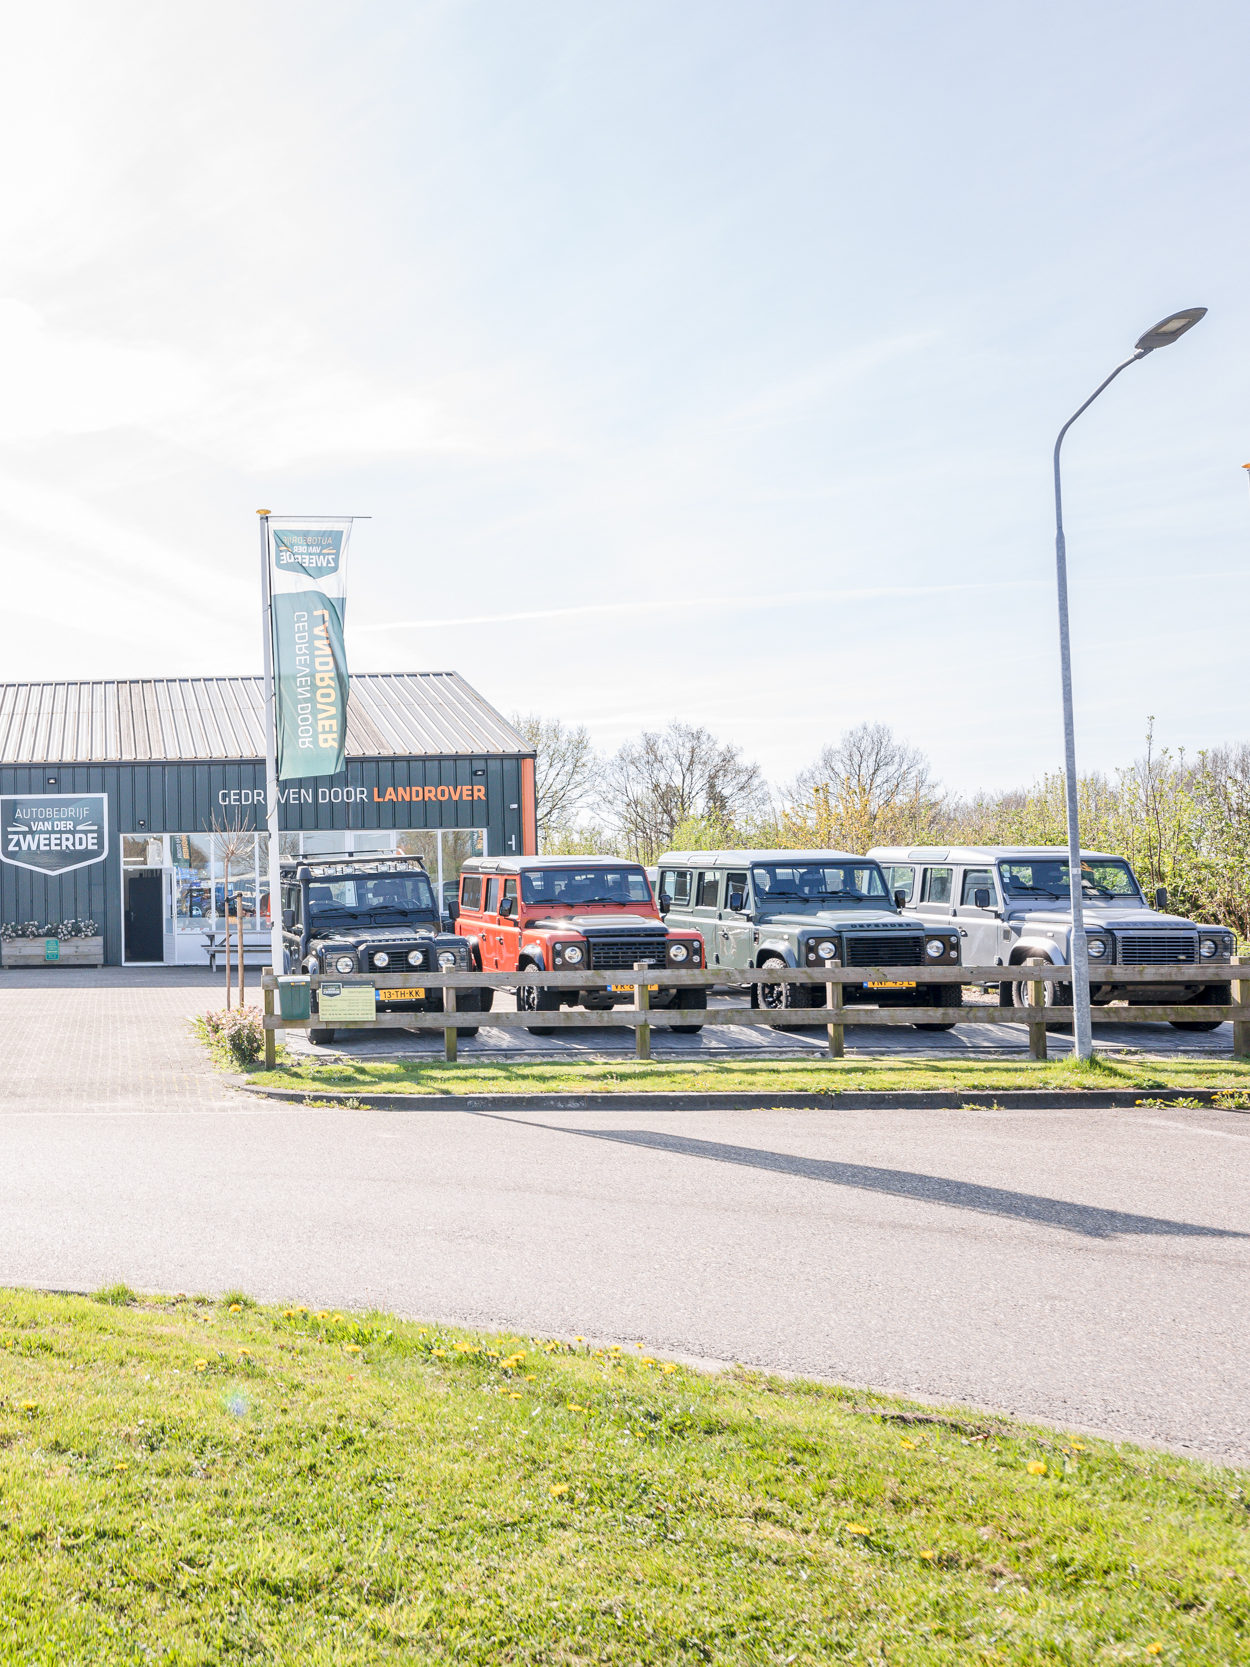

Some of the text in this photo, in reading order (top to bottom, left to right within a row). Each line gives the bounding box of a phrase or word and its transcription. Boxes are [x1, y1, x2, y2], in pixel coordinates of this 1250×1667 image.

[218, 785, 487, 805] GEDRVEN DOOR LANDROVER
[15, 807, 90, 820] AUTOBEDRIJF
[30, 821, 74, 831] VAN DER
[7, 833, 98, 851] ZWEERDE
[383, 989, 421, 999] 13-TH-KK
